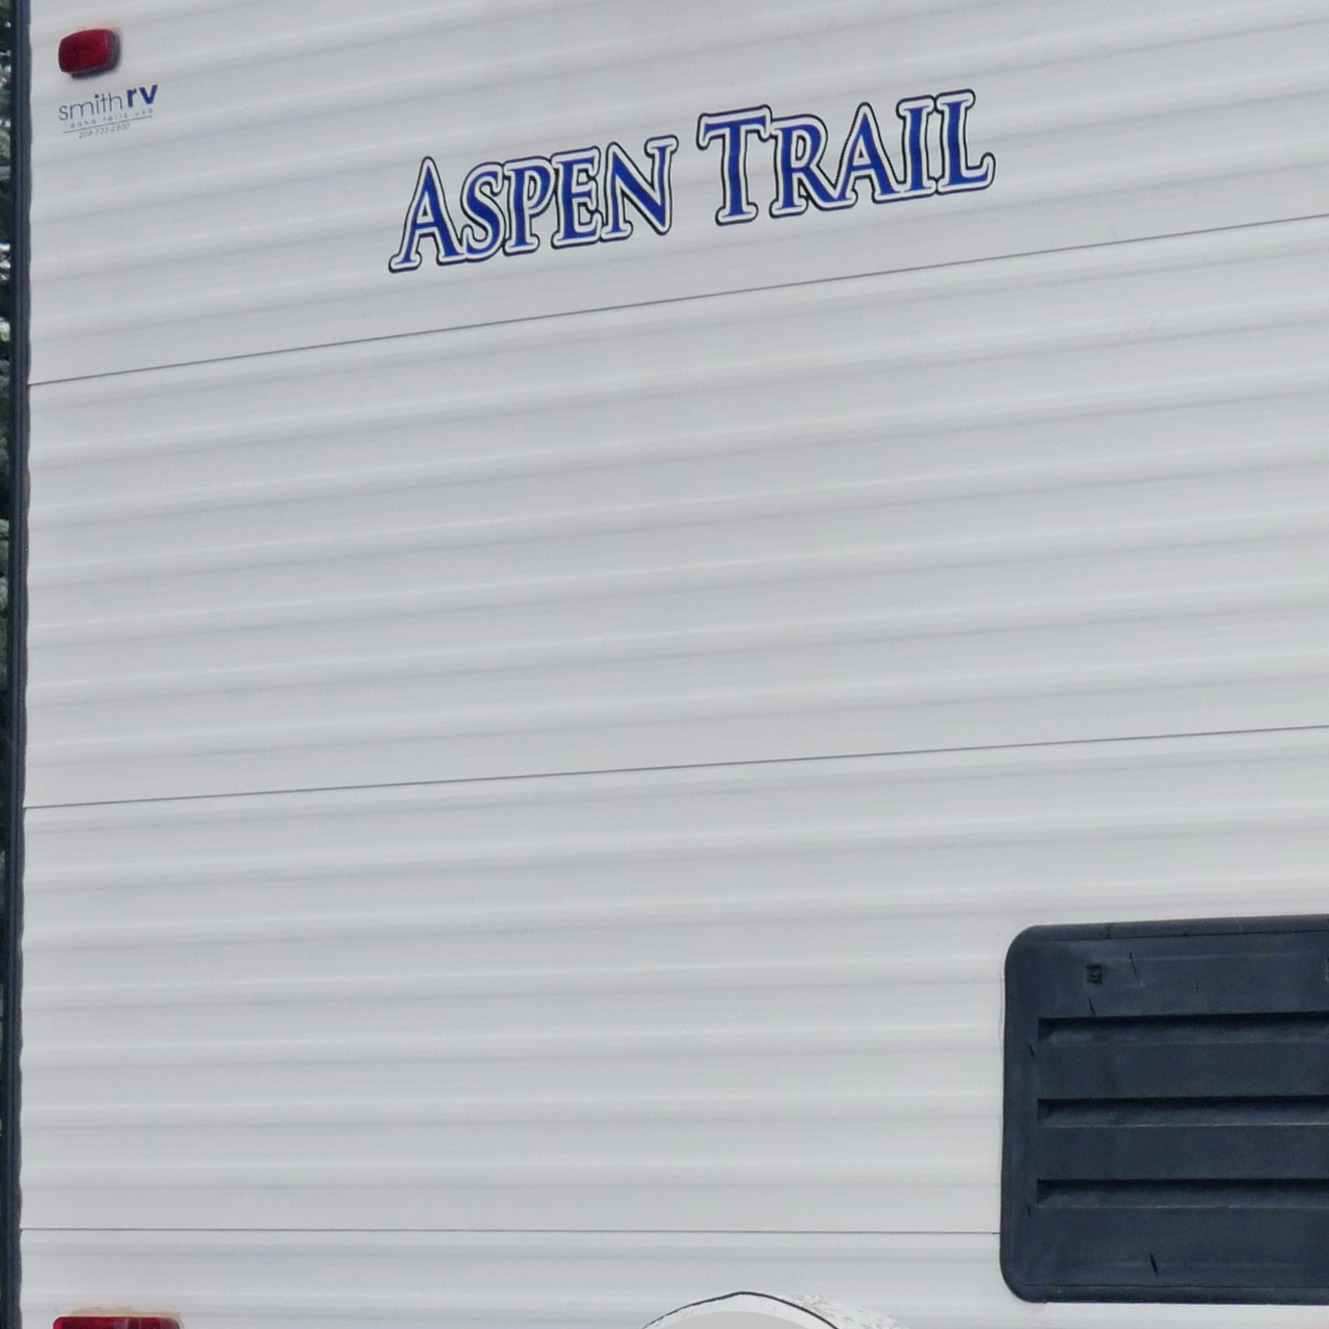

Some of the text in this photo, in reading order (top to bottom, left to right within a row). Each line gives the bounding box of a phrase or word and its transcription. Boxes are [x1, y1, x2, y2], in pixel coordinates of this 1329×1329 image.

[59, 84, 158, 121] smith rv
[388, 89, 996, 273] ASPEN TRAIL
